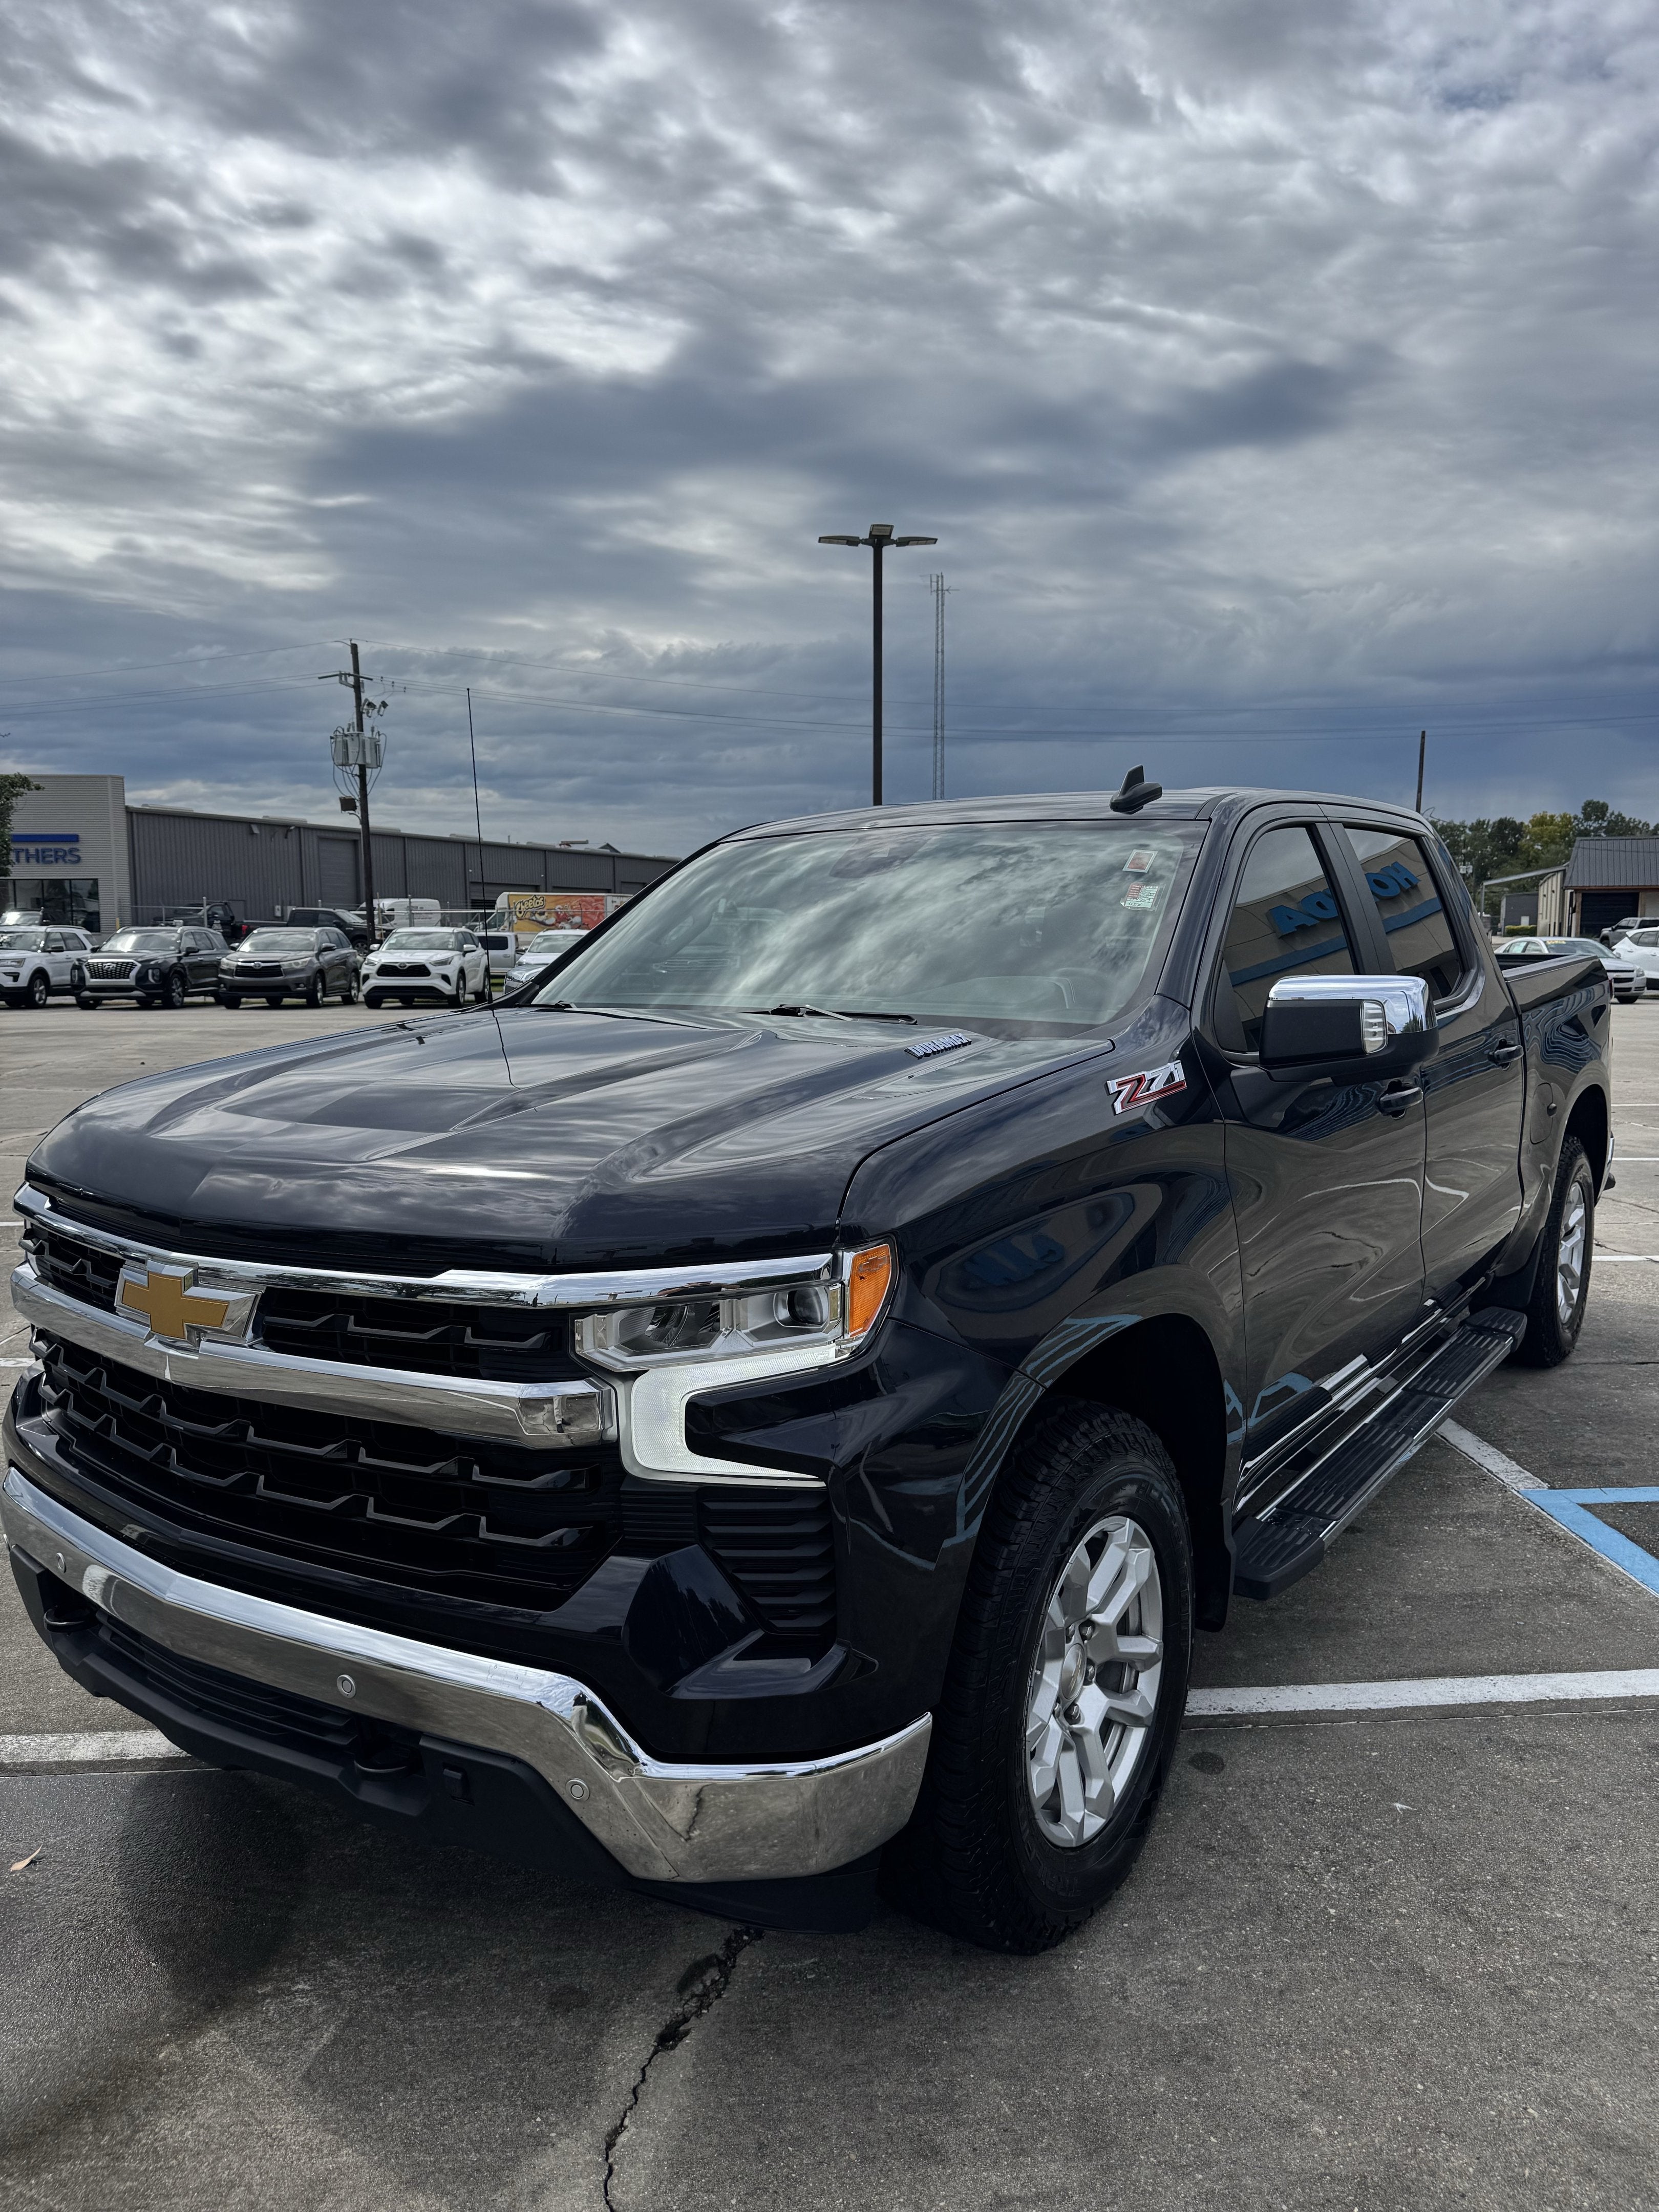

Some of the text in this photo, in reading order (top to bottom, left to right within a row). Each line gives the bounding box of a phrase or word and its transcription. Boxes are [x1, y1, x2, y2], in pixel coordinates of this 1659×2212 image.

[12, 847, 81, 864] THERS
[516, 895, 546, 918] Cheetos
[905, 1033, 972, 1058] DURAMAX
[1105, 1060, 1187, 1115] Z71
